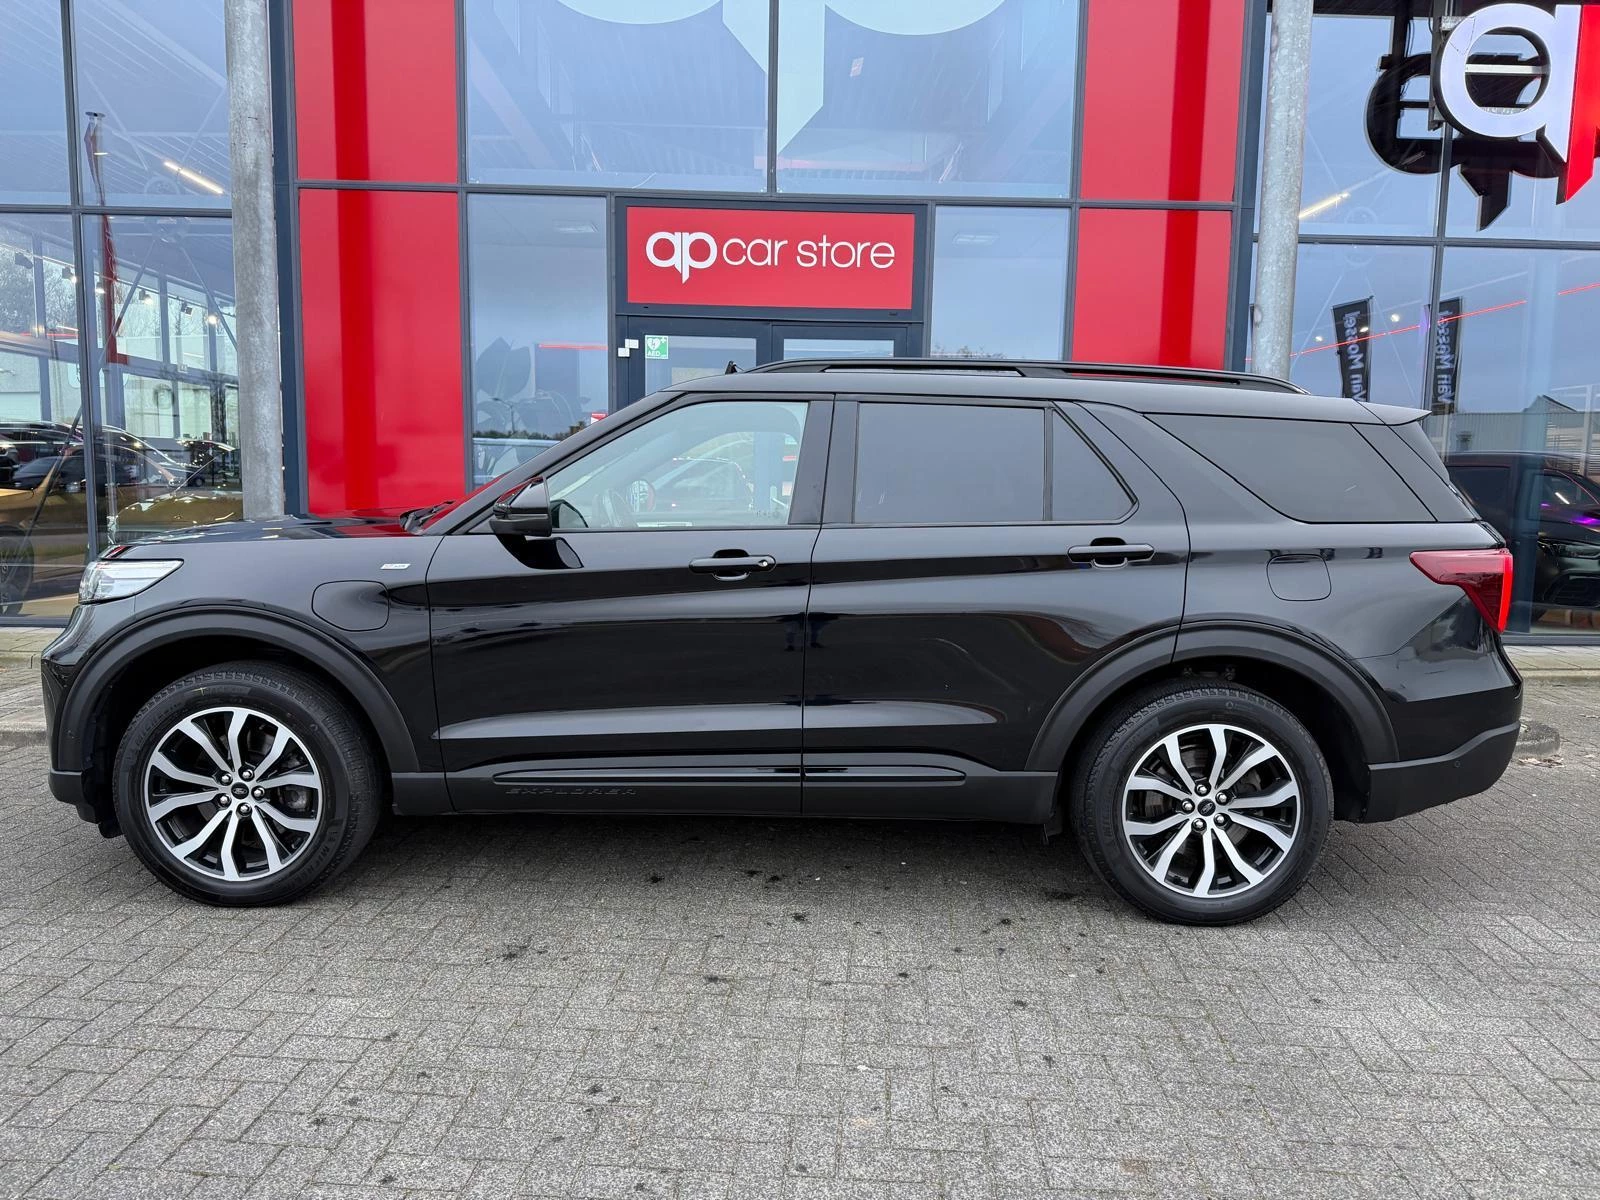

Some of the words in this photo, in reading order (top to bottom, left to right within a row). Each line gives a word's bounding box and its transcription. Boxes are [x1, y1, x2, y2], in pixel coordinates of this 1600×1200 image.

[645, 231, 718, 284] ap
[722, 238, 788, 266] car
[796, 234, 895, 269] store
